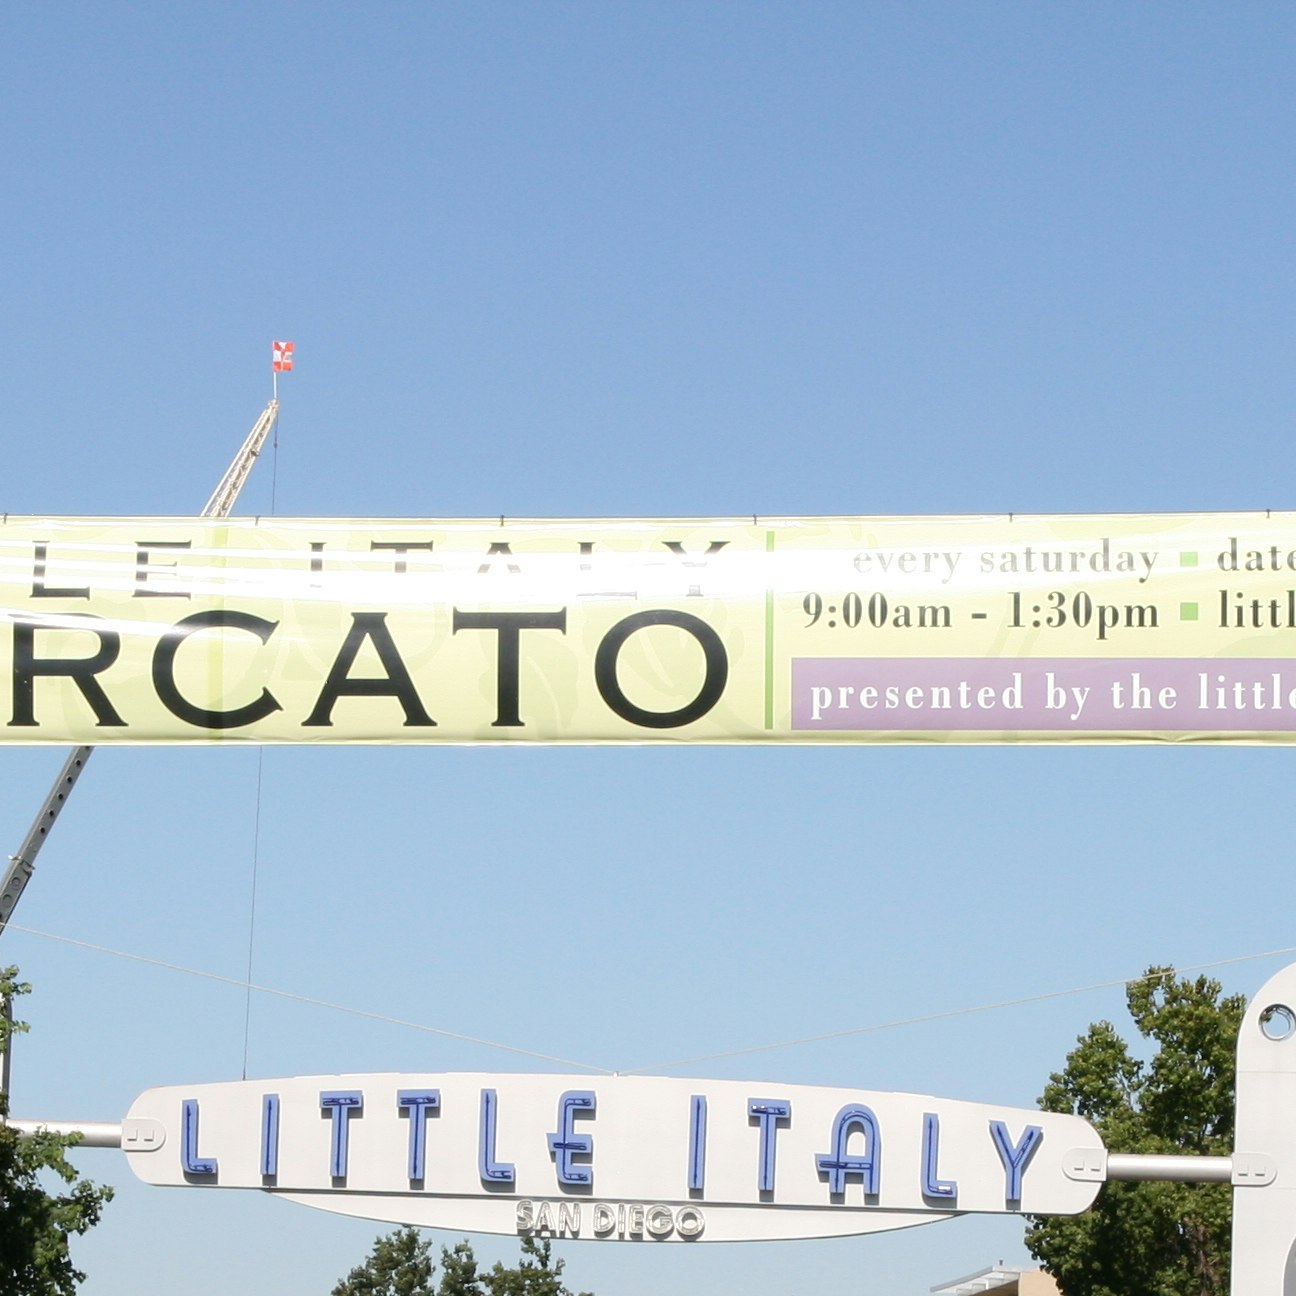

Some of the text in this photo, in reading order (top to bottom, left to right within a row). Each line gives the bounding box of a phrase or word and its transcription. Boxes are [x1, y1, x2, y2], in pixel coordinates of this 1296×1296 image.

[309, 540, 731, 600] ITALY
[852, 537, 1160, 584] every saturday
[803, 591, 954, 629] 9:00am
[1006, 591, 1160, 640] 1:30pm
[810, 672, 1025, 721] presented
[1045, 672, 1091, 721] by
[1110, 672, 1178, 710] the
[181, 1088, 1044, 1202] LITTLE ITALY
[516, 1200, 705, 1240] SAN DIEGO
